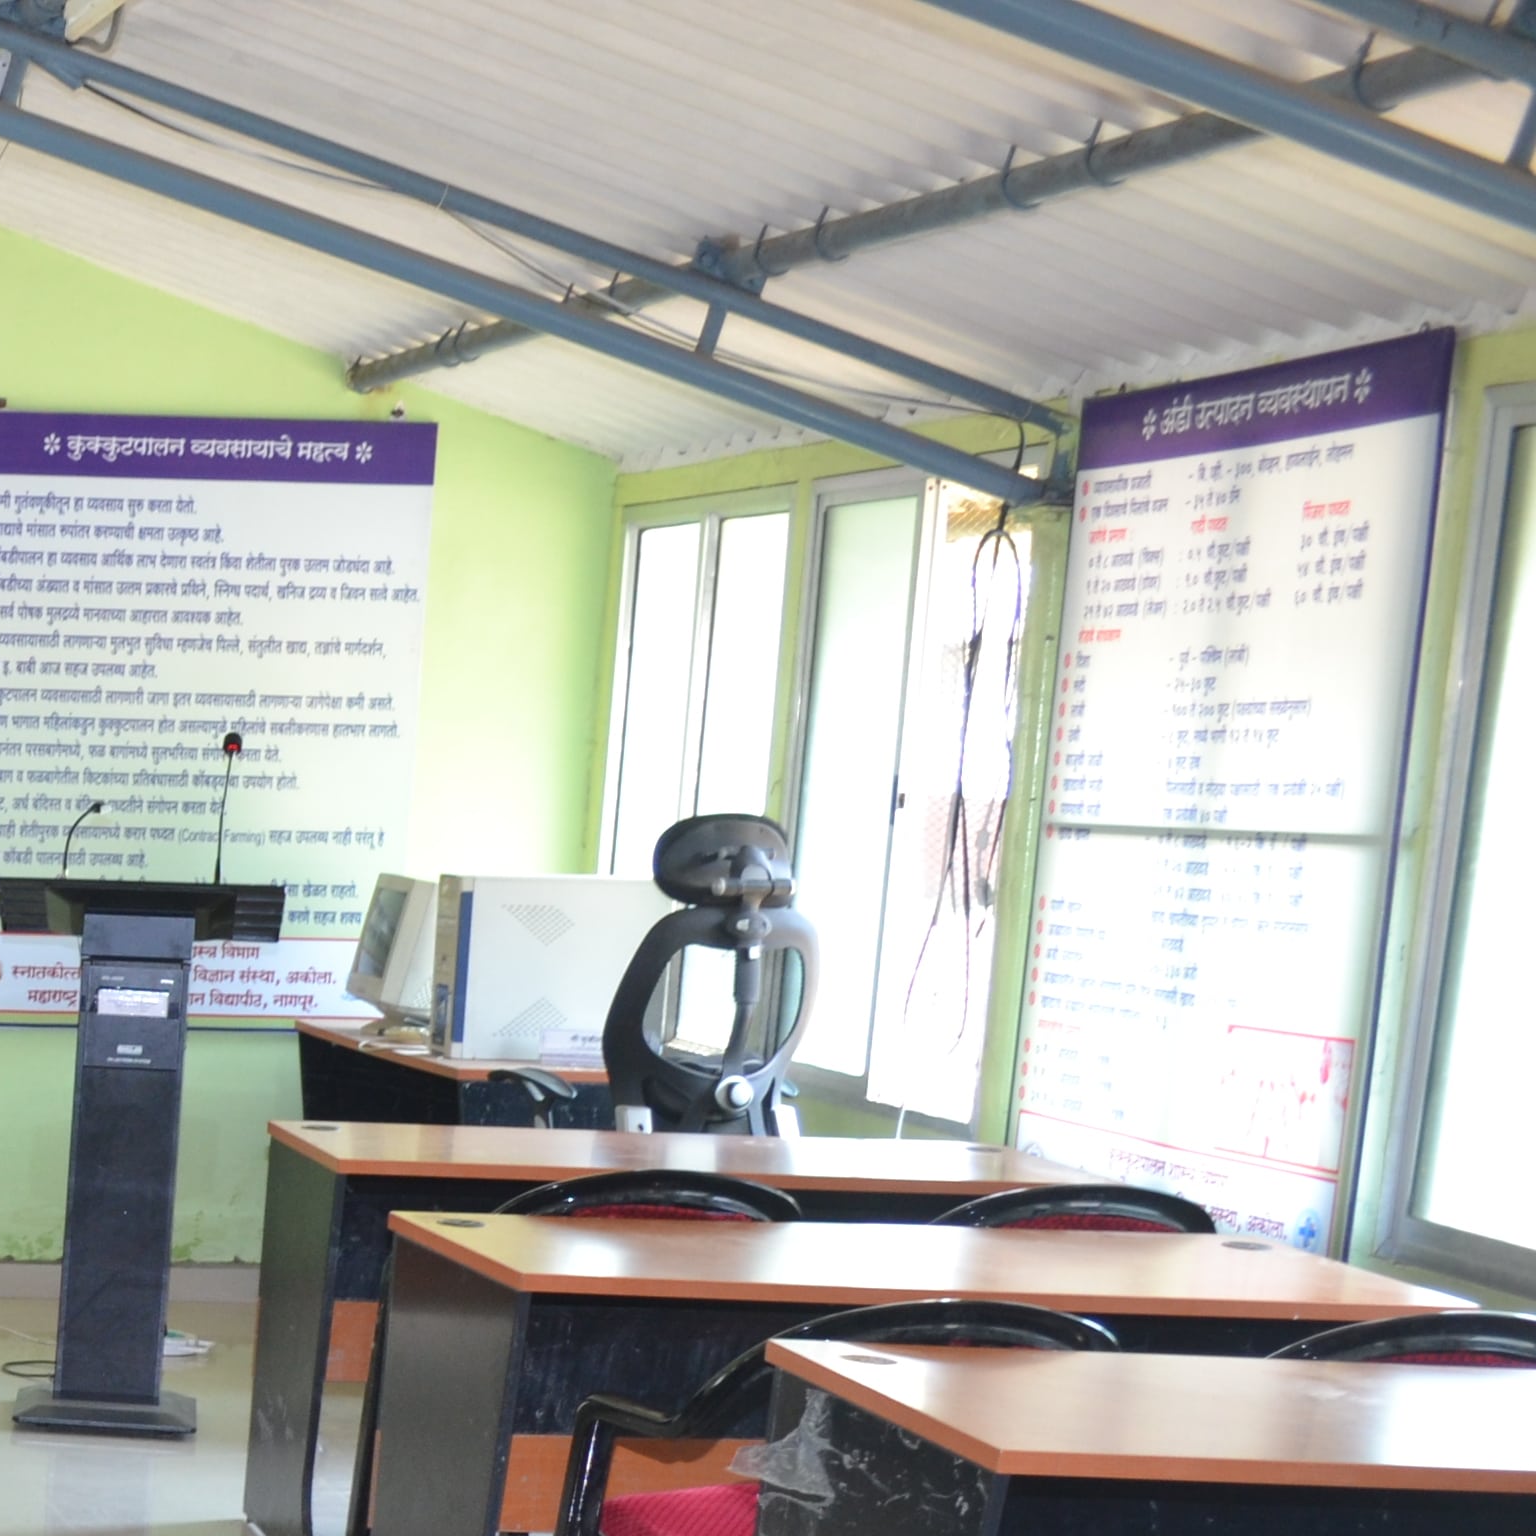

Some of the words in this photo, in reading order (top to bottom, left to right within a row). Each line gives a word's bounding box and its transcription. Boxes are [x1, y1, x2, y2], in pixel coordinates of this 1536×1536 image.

[68, 435, 185, 464] कुक्कुटपालन
[190, 435, 293, 460] व्यवसायाचे
[297, 441, 350, 463] महत्व
